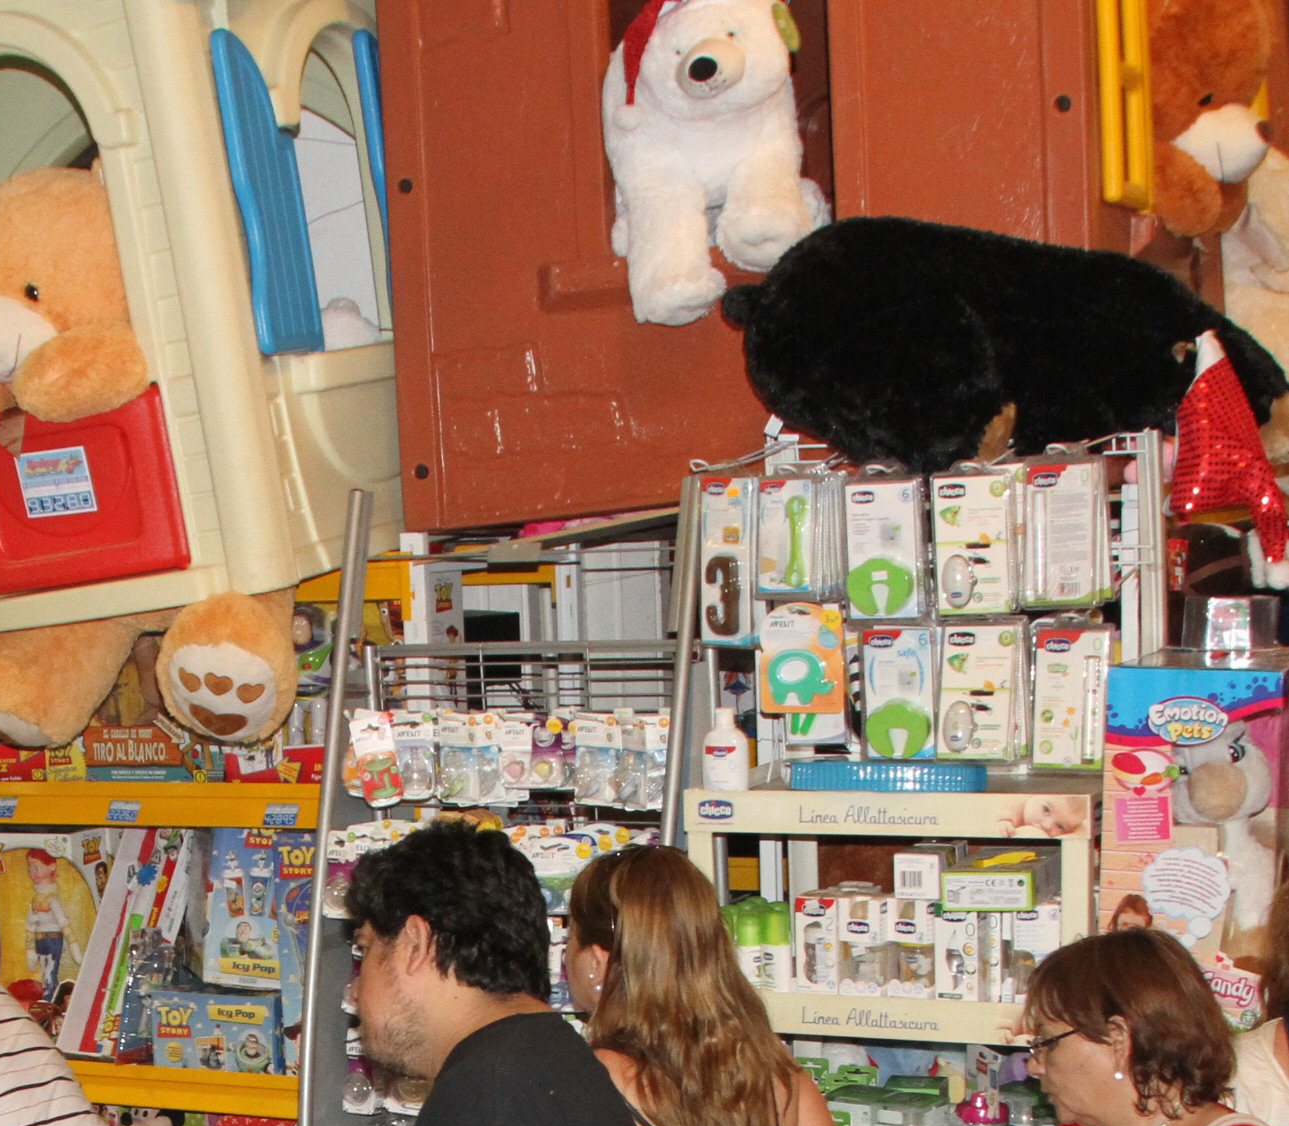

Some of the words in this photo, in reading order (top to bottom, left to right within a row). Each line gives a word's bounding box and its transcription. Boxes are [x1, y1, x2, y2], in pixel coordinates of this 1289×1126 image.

[1149, 702, 1229, 726] Emotion
[1167, 721, 1213, 742] Pets
[93, 743, 113, 762] TIRO
[116, 742, 127, 760] AL
[699, 802, 733, 818] chicco
[844, 804, 940, 828] Allattasicura
[82, 836, 101, 853] TOY
[278, 846, 315, 866] TOY
[282, 866, 313, 875] STORY
[232, 962, 250, 973] Icy
[252, 963, 276, 975] Pop
[157, 1006, 193, 1025] TOY
[217, 1008, 233, 1019] Icy
[235, 1009, 255, 1020] Pop
[846, 1006, 940, 1032] Allattasicura
[159, 1026, 190, 1036] STORY
